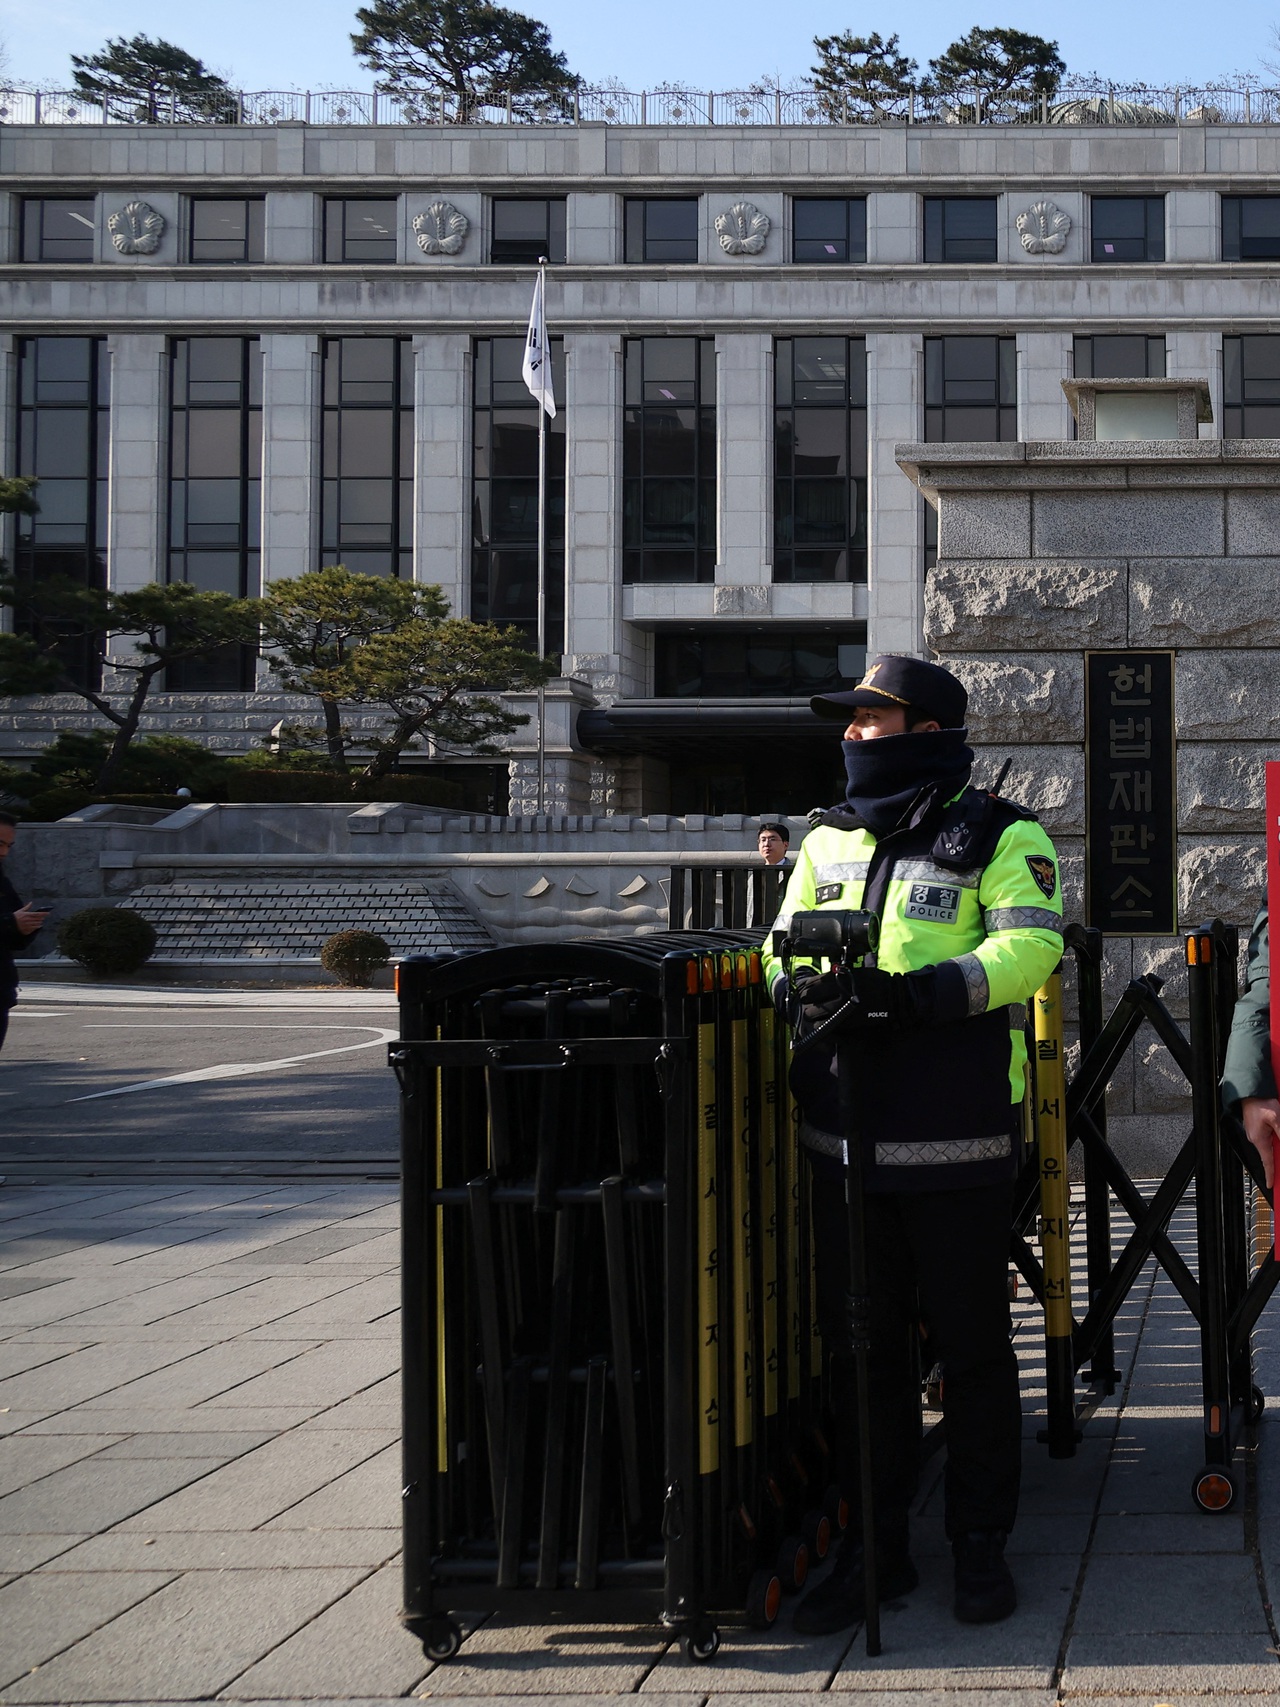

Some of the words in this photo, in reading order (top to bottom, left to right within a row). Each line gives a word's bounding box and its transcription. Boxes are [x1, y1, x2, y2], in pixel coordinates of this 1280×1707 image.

[1108, 663, 1155, 918] 헌법재판소
[910, 905, 953, 920] POLICE
[914, 885, 956, 908] 경찰
[1037, 1039, 1065, 1299] 질서유지선
